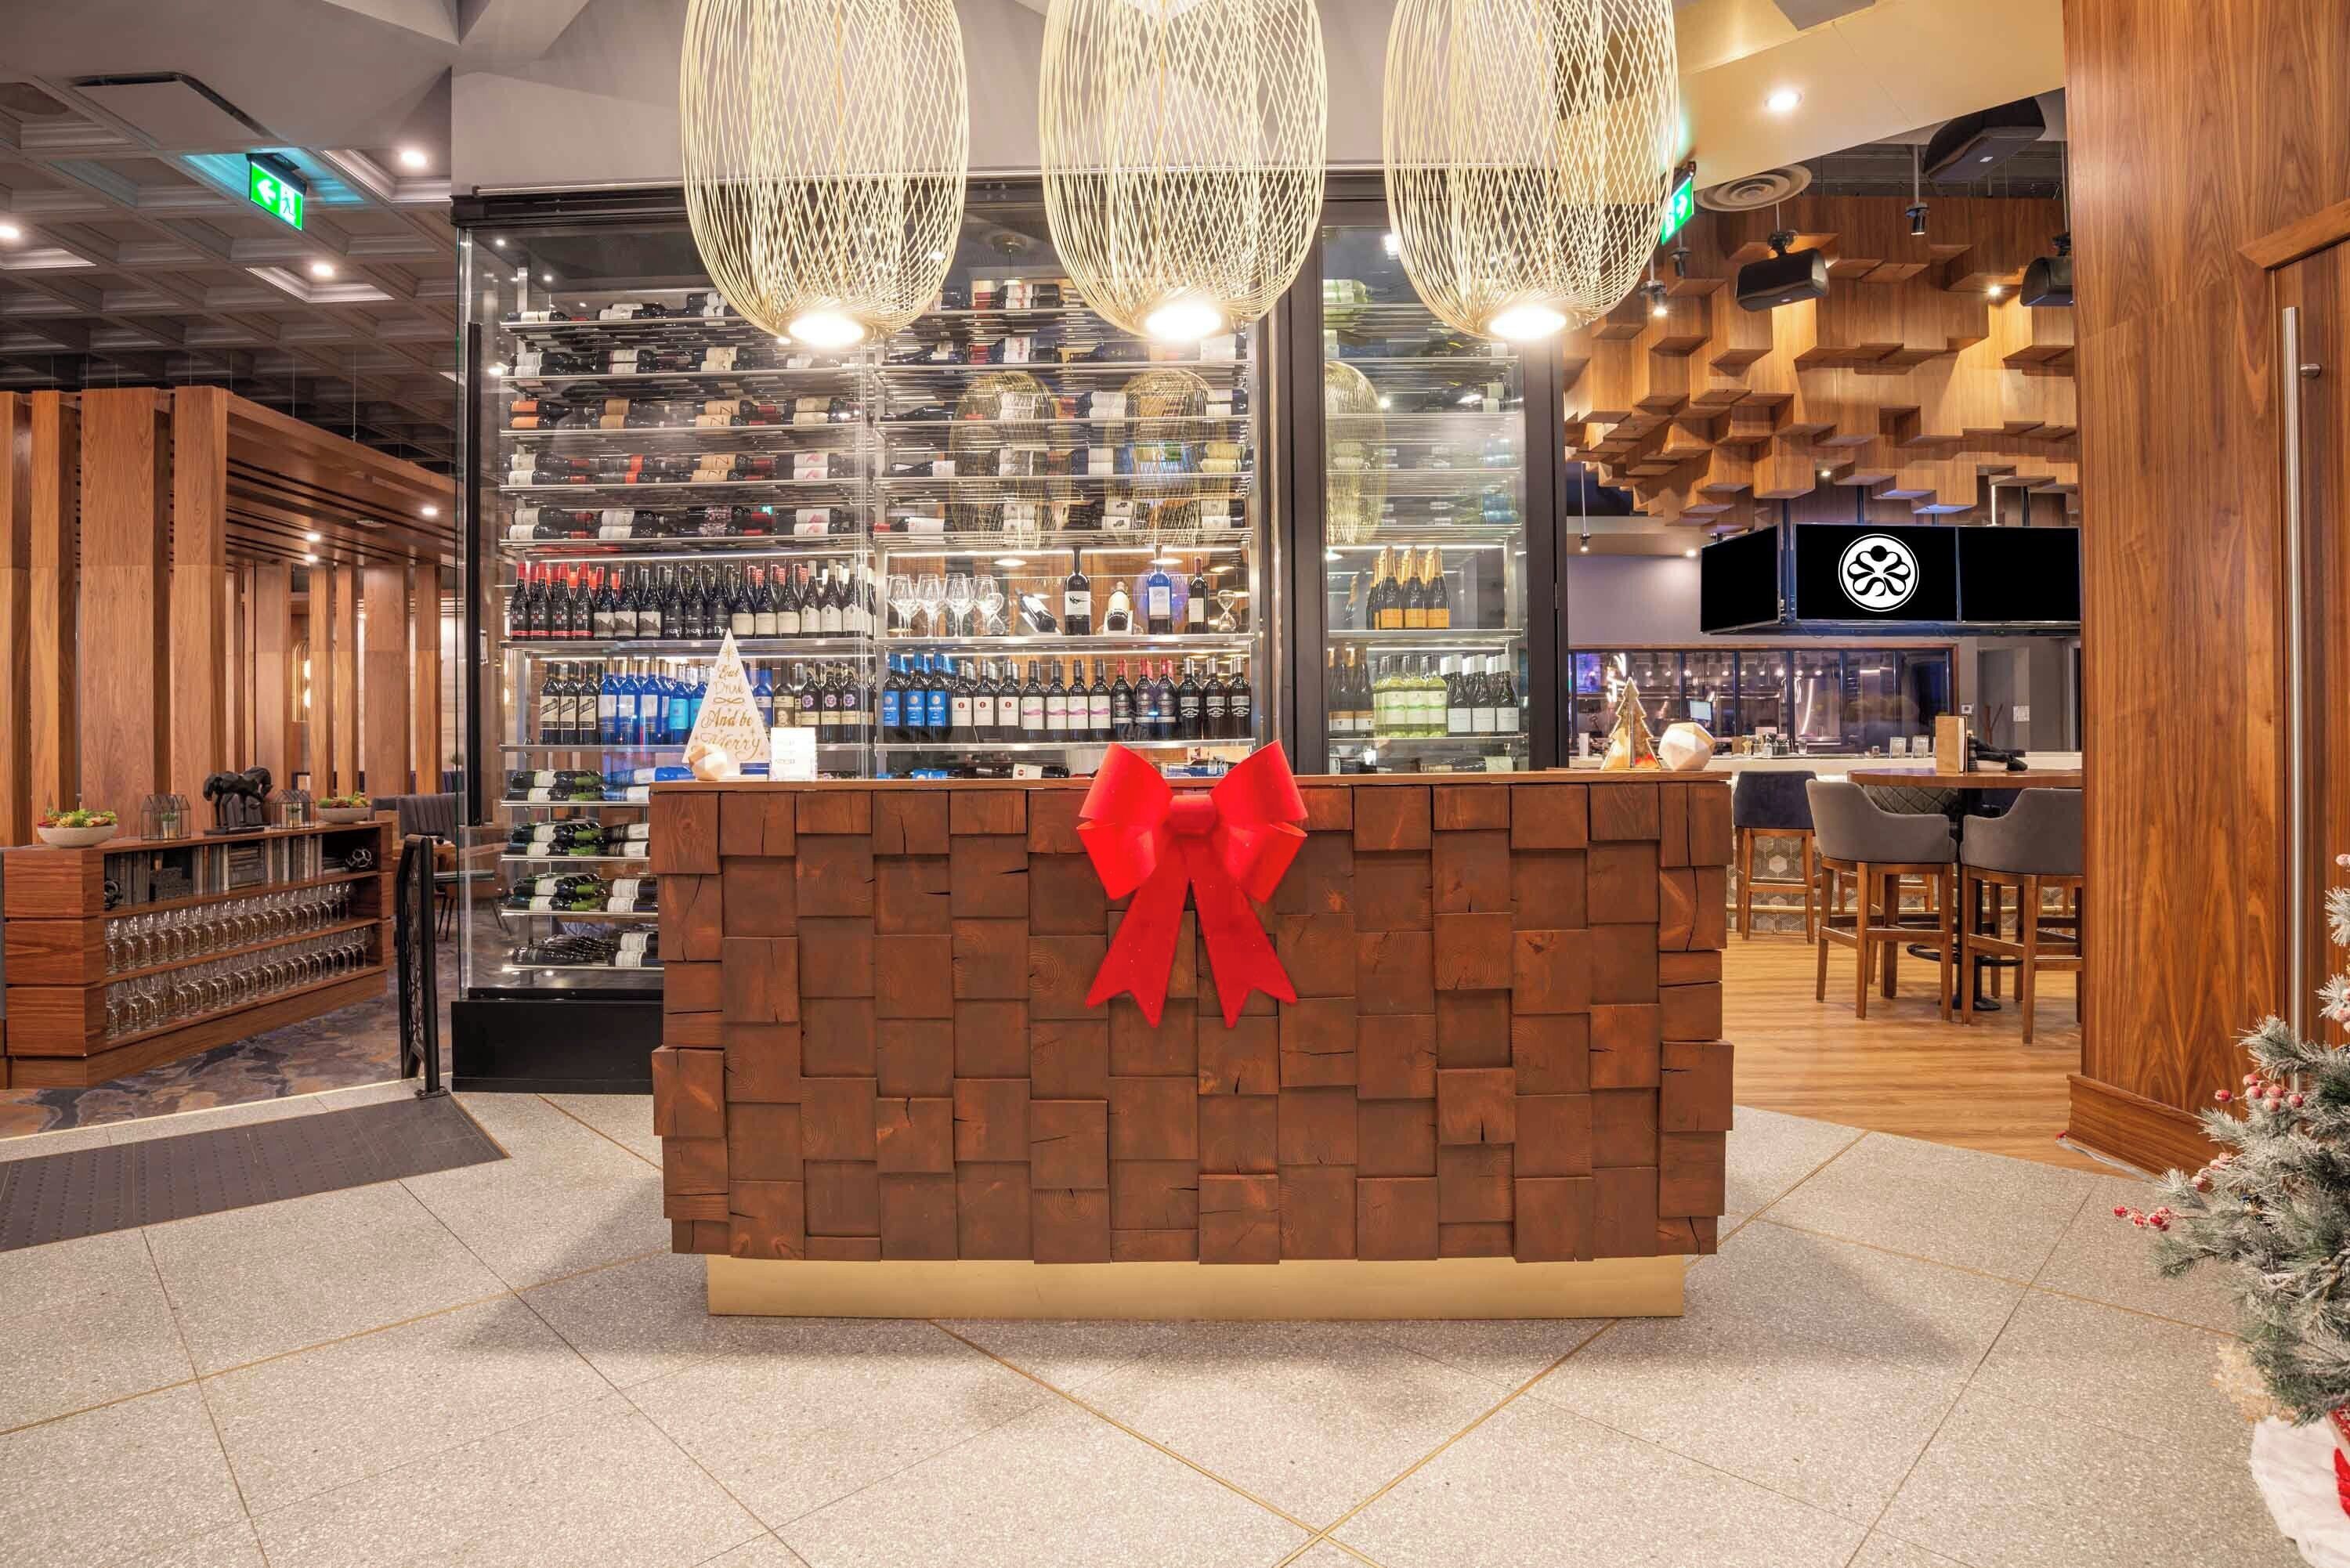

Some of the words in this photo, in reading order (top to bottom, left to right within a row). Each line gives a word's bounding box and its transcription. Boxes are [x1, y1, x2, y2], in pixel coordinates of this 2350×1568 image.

[714, 678, 745, 695] Drink
[701, 708, 738, 728] And
[739, 710, 752, 727] be
